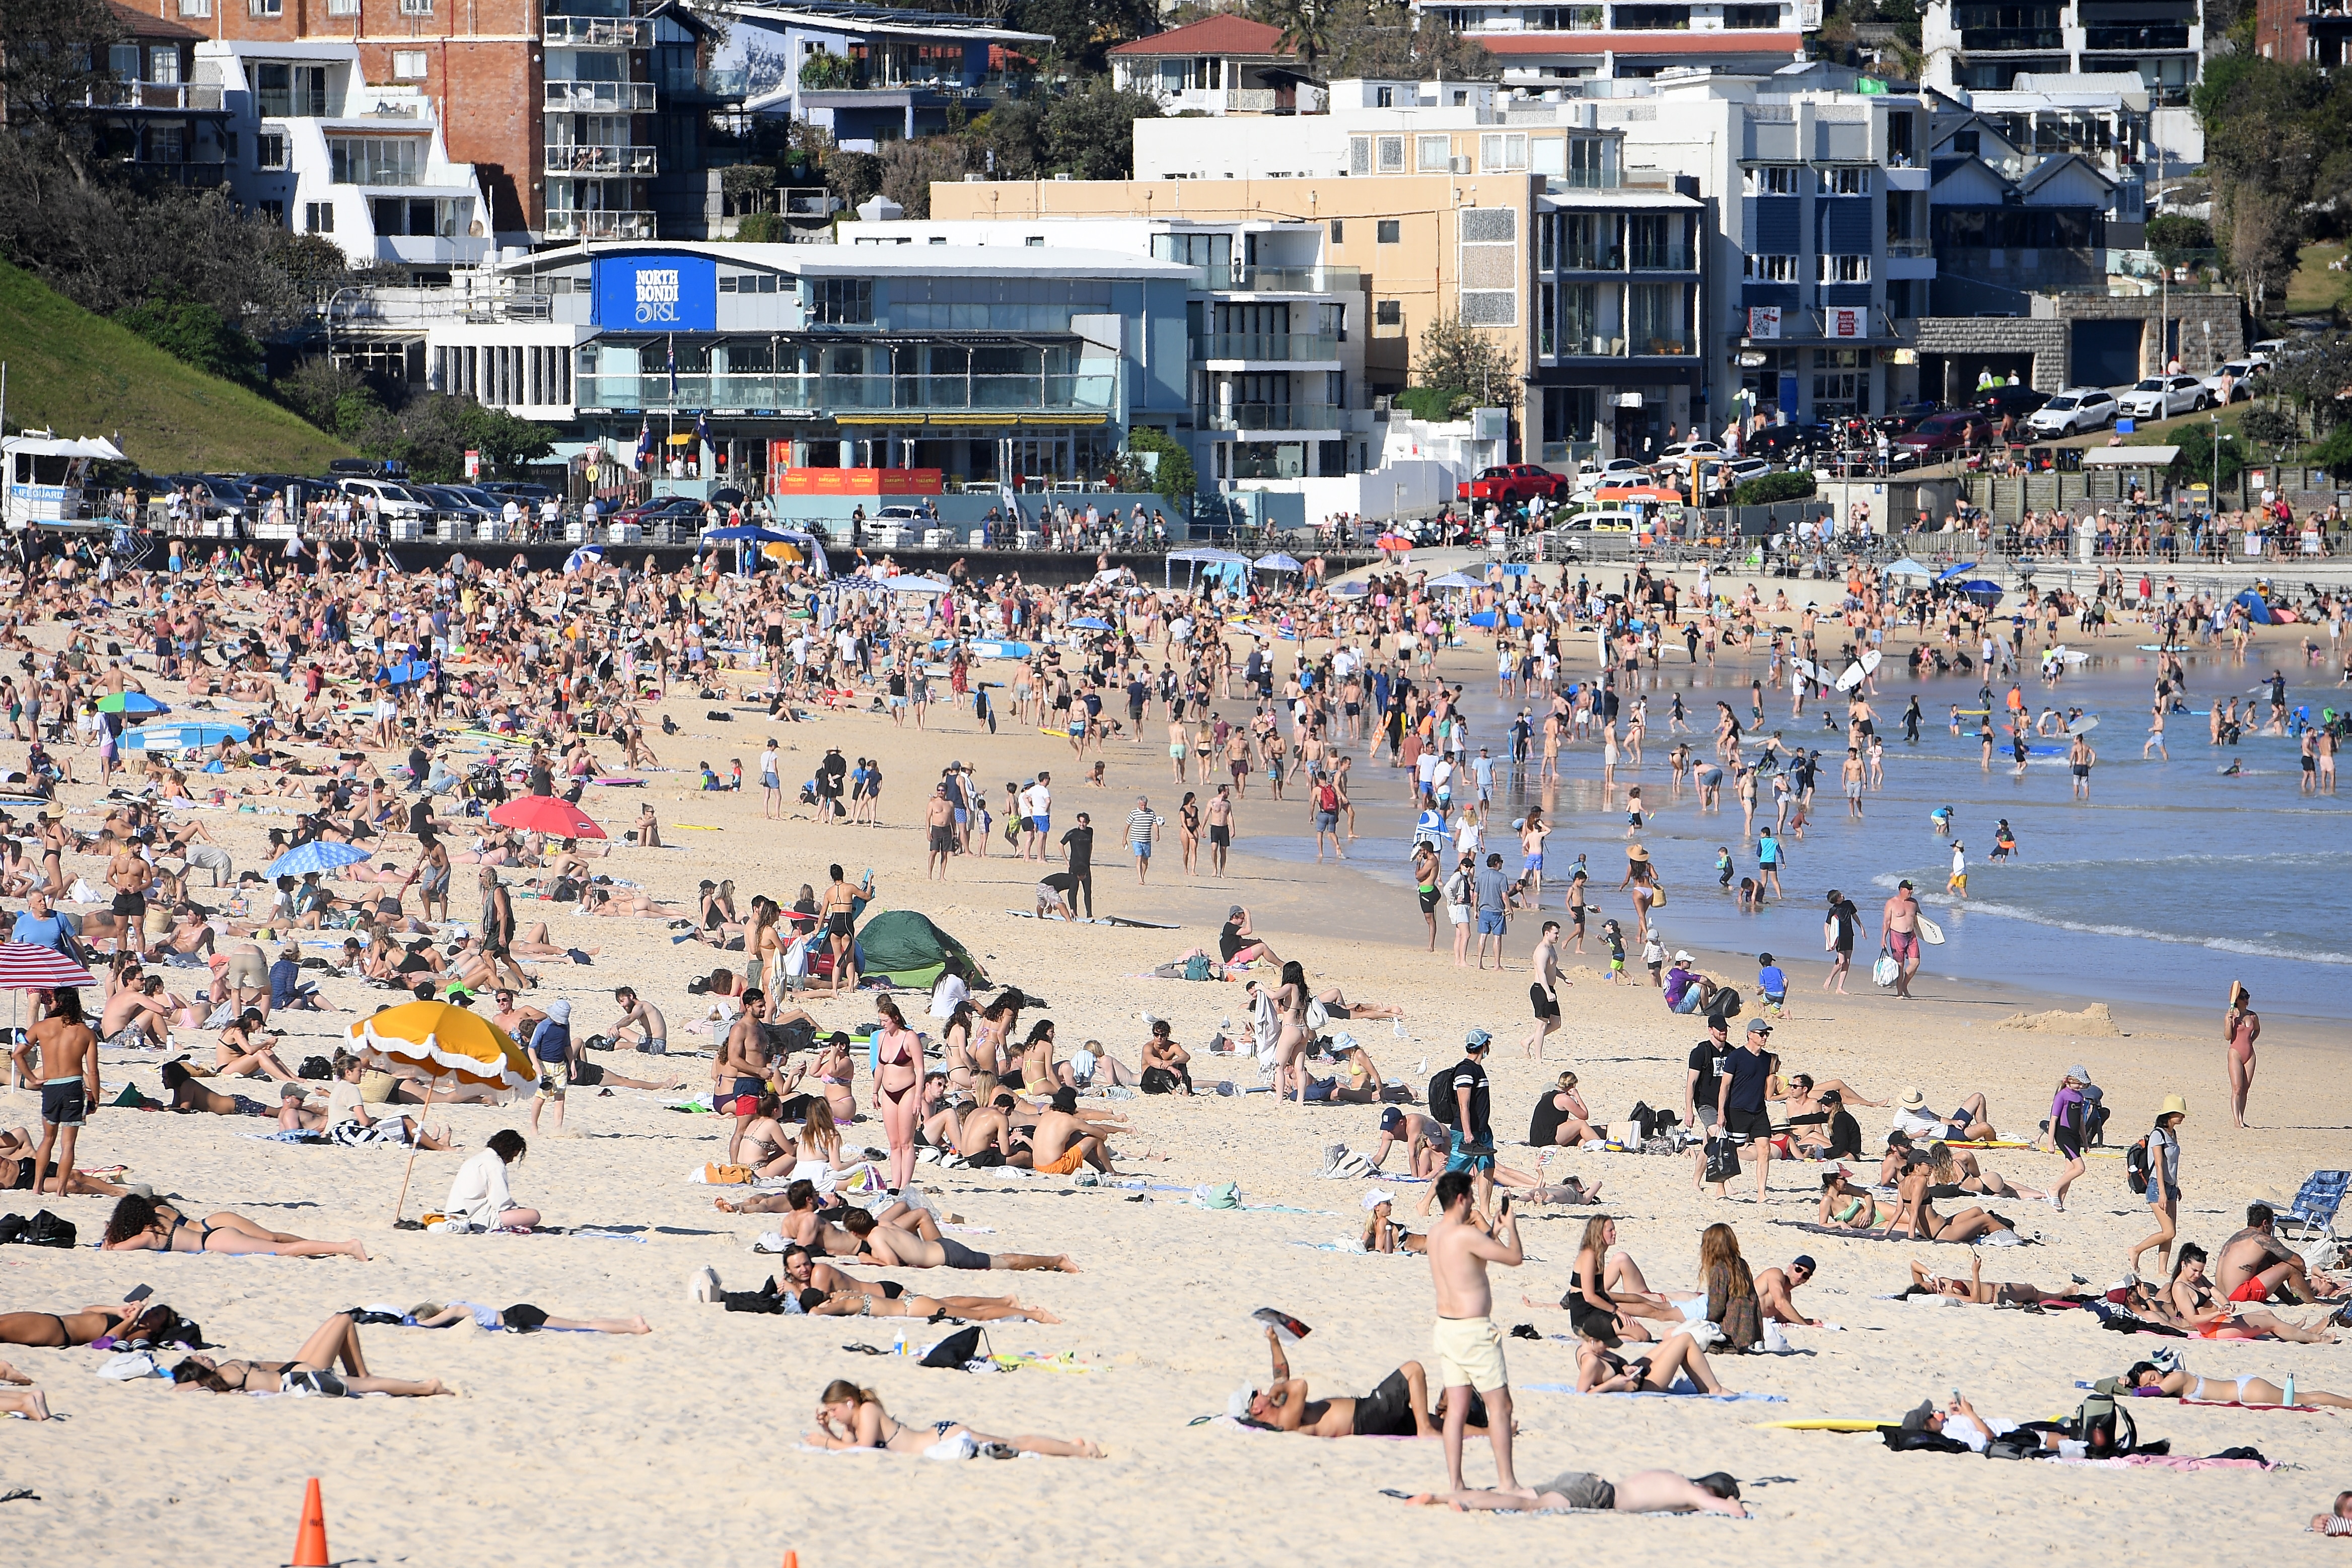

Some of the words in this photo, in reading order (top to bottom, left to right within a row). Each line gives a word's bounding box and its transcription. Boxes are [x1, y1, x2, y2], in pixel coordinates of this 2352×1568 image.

[635, 269, 679, 285] NORTH
[635, 285, 679, 302] BONDI
[653, 302, 680, 321] RSL
[14, 488, 63, 499] LIFEGUARD
[1487, 564, 1520, 574] RMP
[1522, 565, 1527, 574] 7
